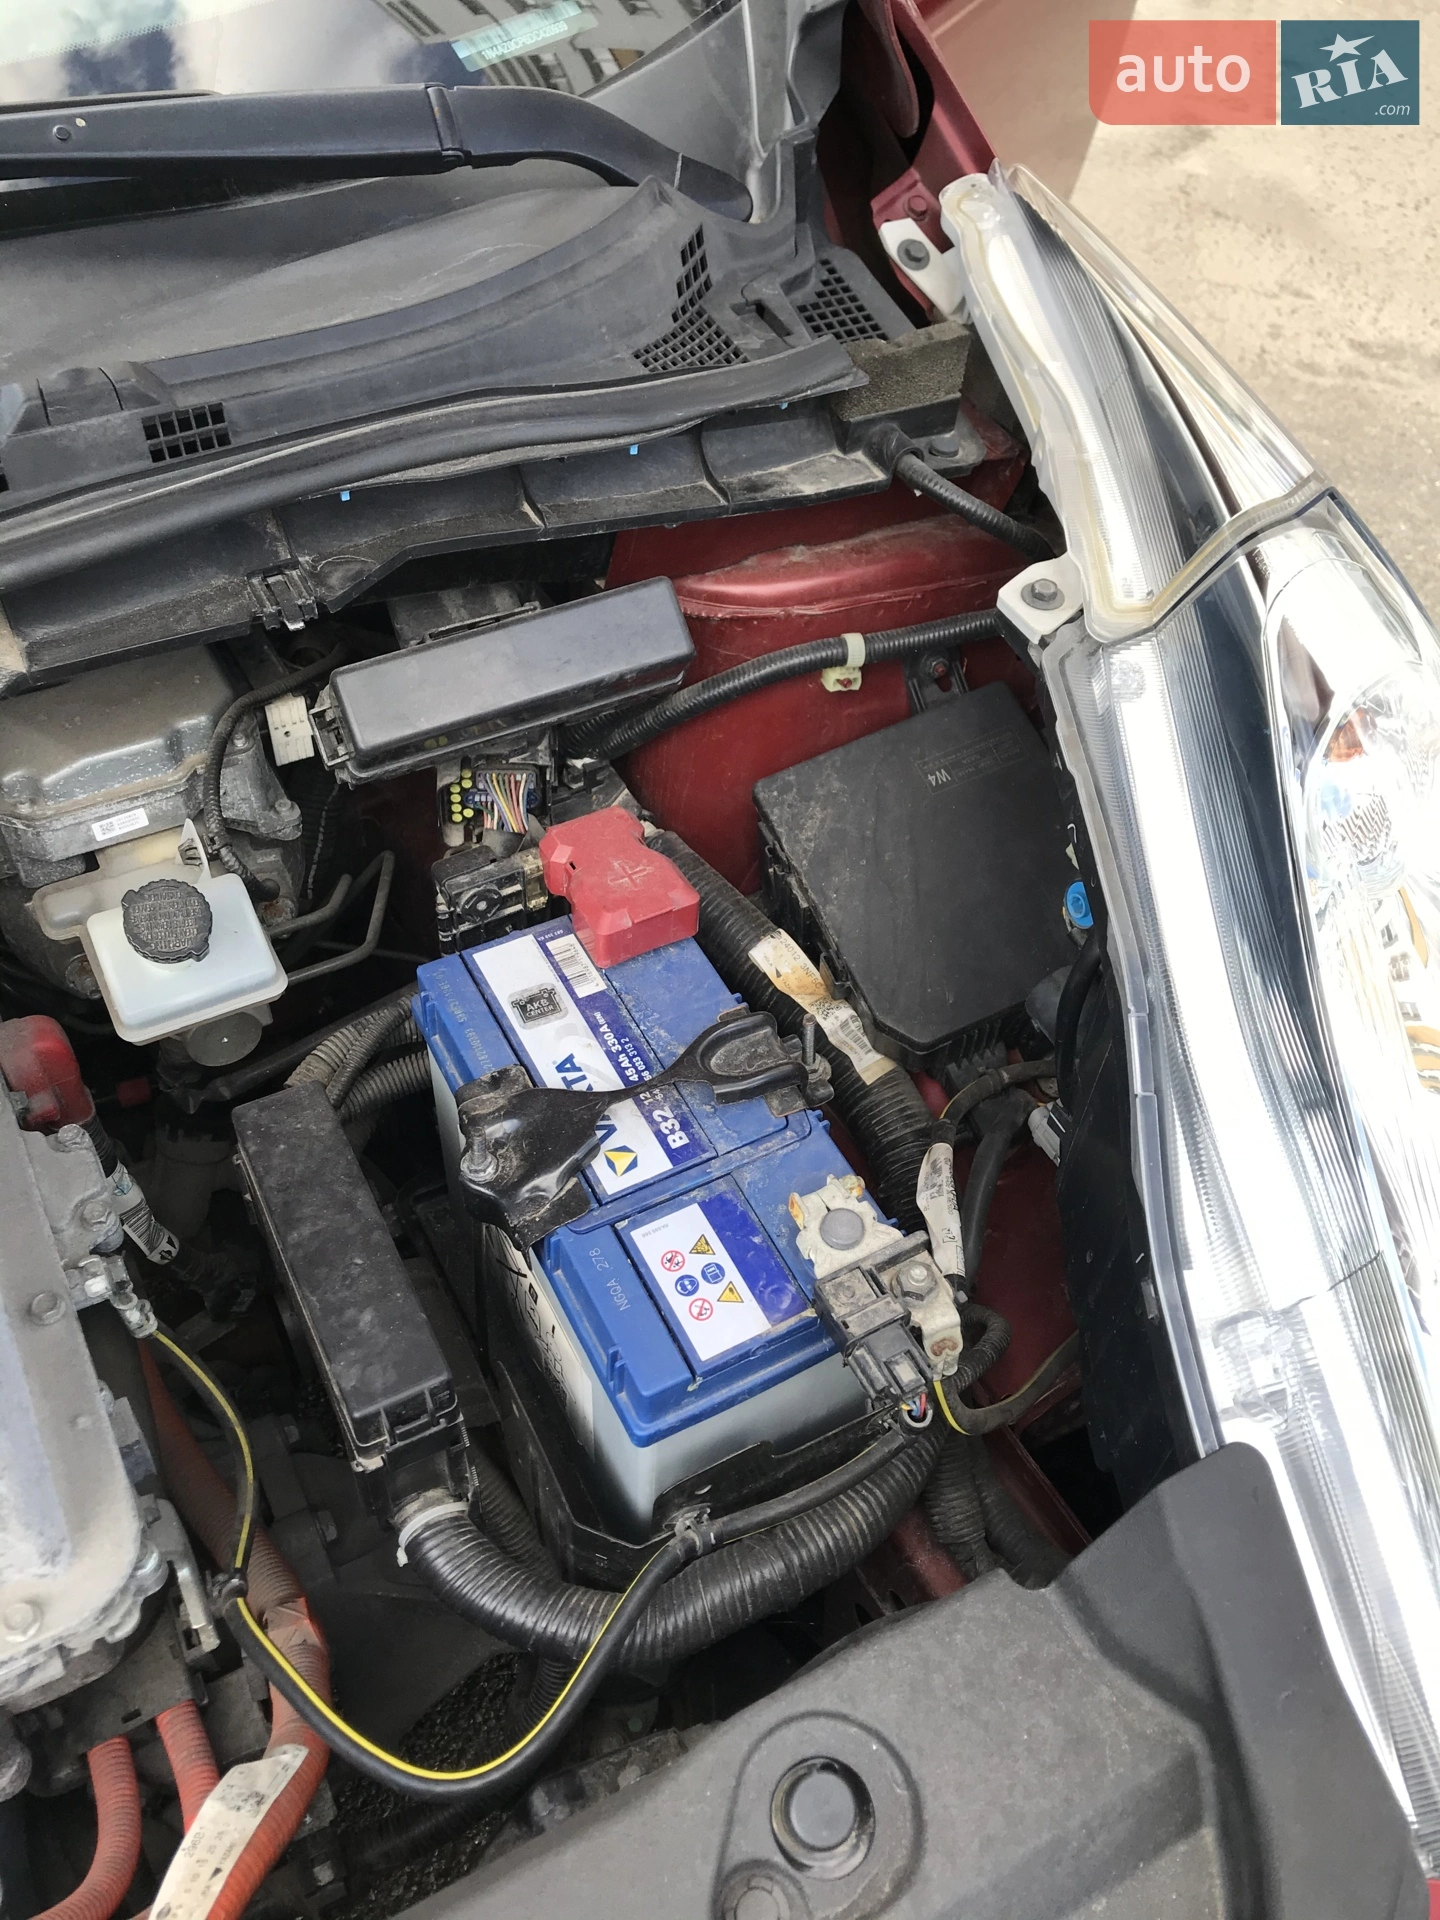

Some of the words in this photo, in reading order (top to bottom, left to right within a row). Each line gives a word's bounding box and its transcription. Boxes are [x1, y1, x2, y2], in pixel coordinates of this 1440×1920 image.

[927, 768, 952, 786] W4
[780, 937, 801, 962] 24012
[526, 999, 550, 1012] AKB
[526, 1004, 555, 1017] CENTER
[555, 1053, 618, 1146] VTA
[652, 1105, 690, 1150] B32
[589, 1247, 610, 1271] 278
[606, 1277, 631, 1311] NGQA
